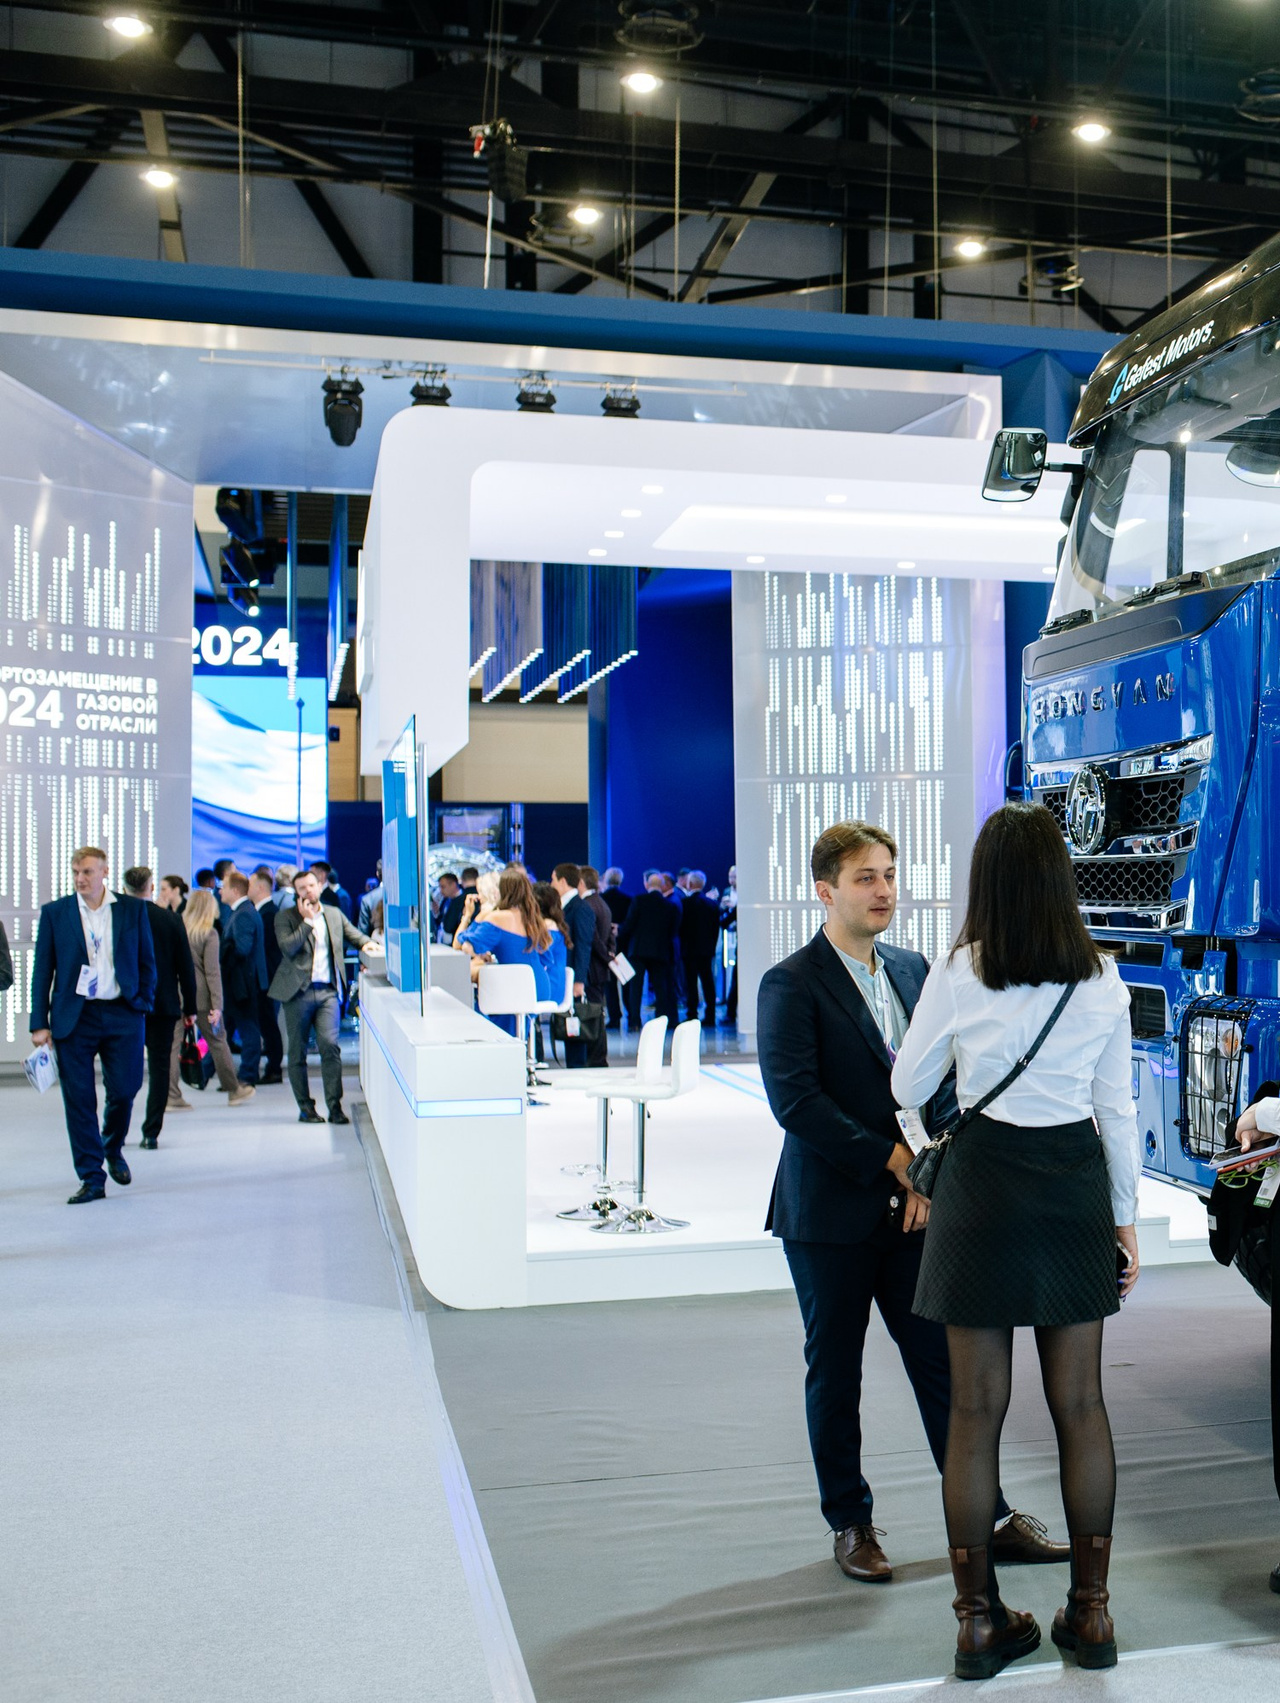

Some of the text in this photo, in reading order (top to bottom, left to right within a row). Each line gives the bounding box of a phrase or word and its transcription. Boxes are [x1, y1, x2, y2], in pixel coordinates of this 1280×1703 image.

[1123, 346, 1168, 392] Gefest
[1162, 320, 1215, 368] Motors
[0, 666, 158, 694] РТОЗАМЕЩЕНИЕ В
[76, 693, 158, 714] ГАЗОВОЙ
[76, 714, 158, 734] ОТРАСЛИ
